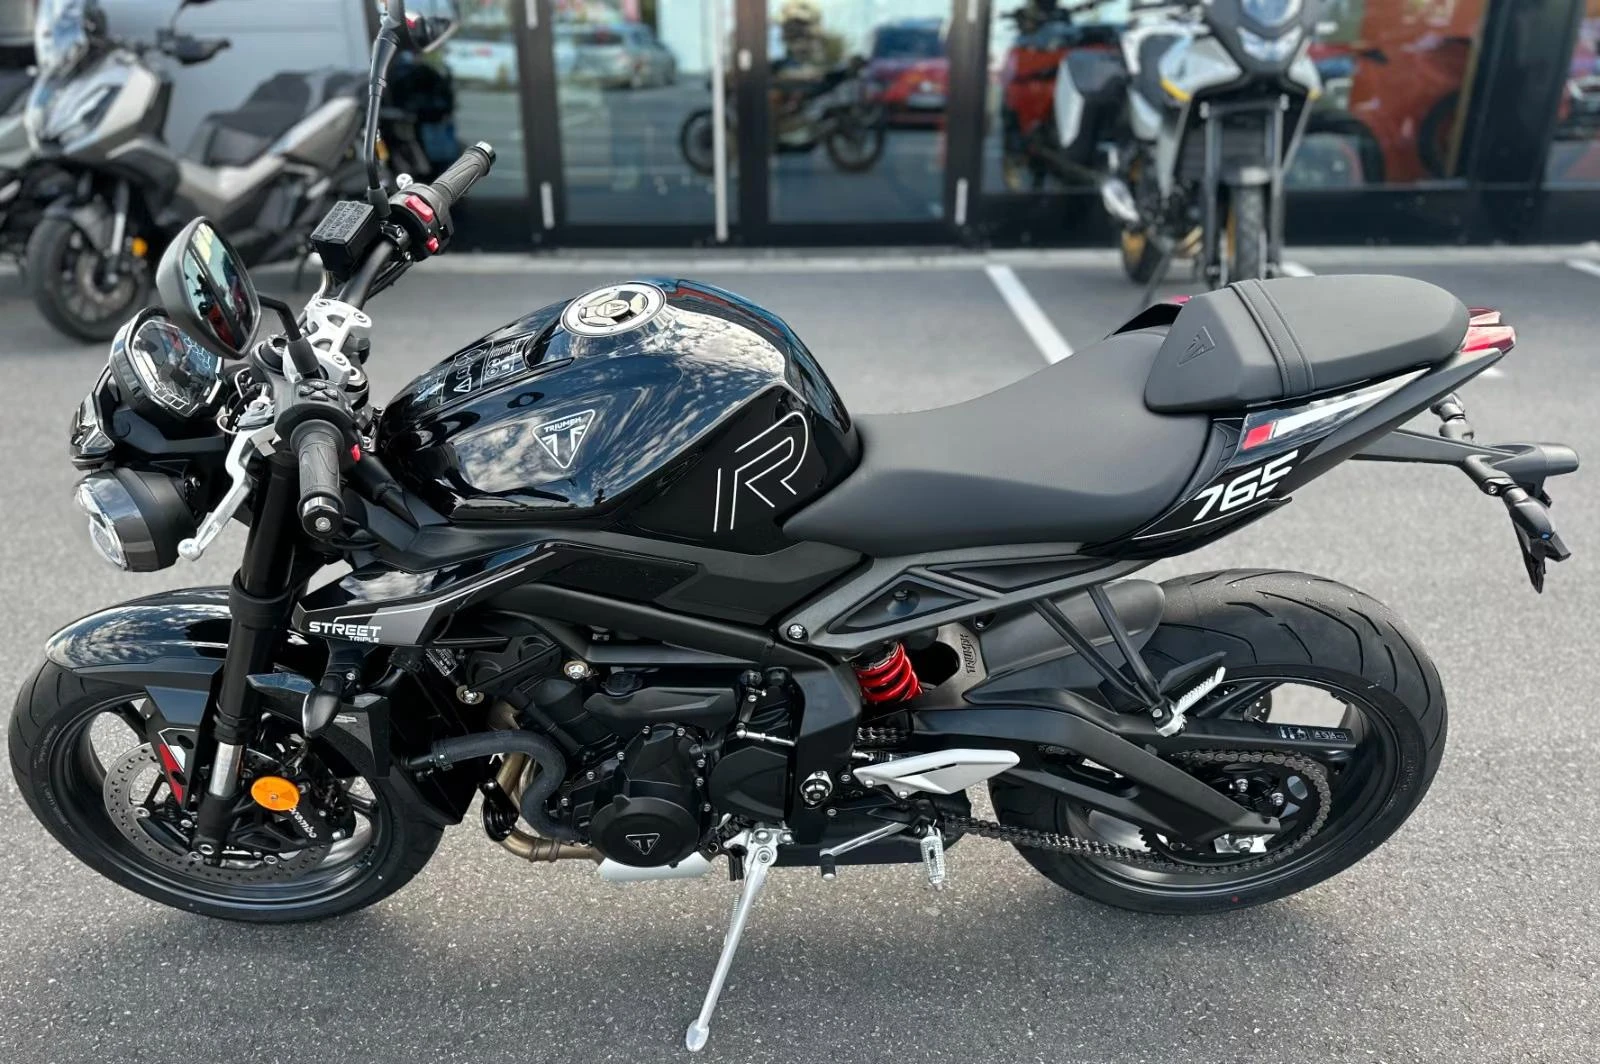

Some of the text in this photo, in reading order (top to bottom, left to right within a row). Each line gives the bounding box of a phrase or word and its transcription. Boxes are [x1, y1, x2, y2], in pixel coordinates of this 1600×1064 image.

[544, 417, 582, 432] TRIUMPH
[713, 411, 809, 532] R
[1193, 449, 1299, 521] 765
[309, 621, 382, 637] STREET
[960, 633, 976, 673] TRIUMPH
